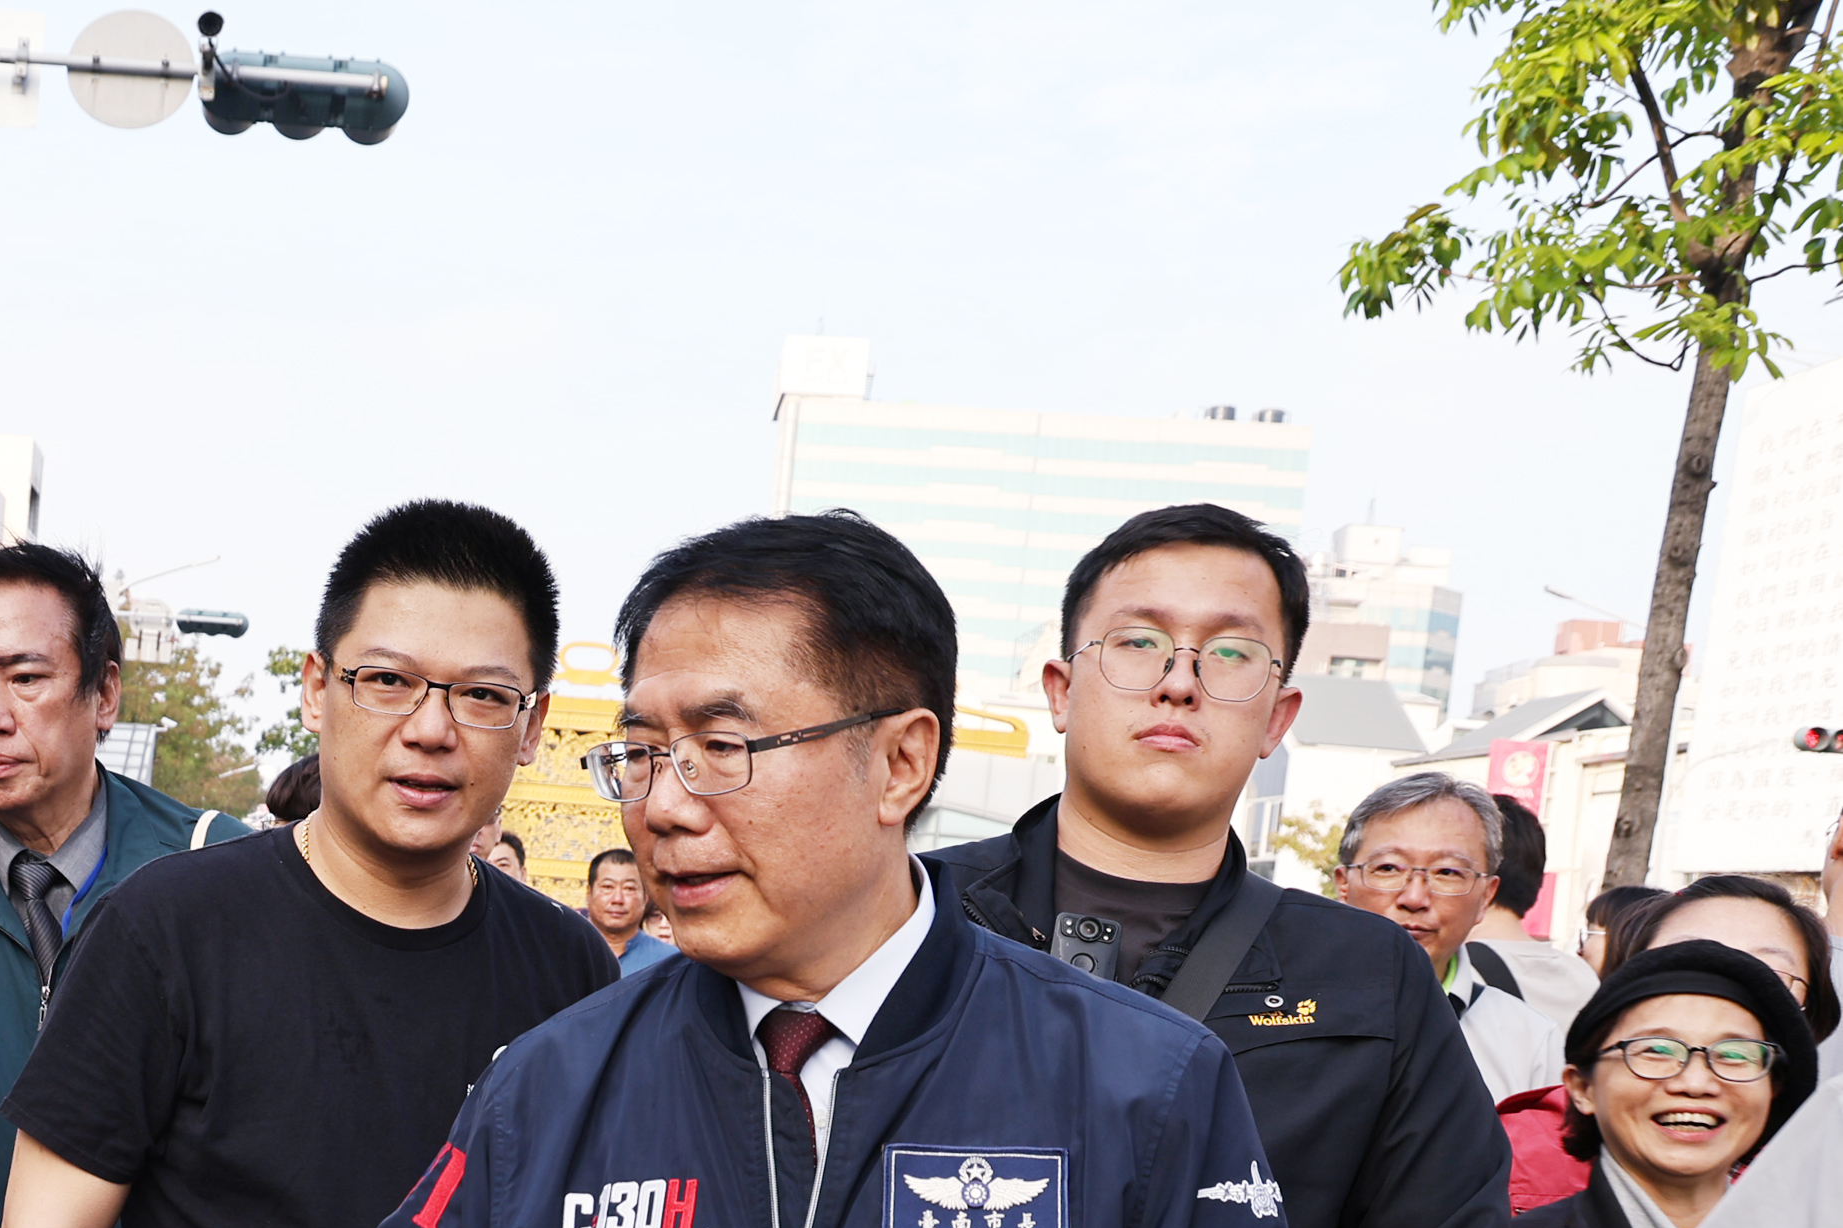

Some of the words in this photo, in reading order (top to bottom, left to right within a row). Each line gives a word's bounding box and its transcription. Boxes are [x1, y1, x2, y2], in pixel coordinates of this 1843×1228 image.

[1738, 540, 1843, 578] 如同行在
[1248, 1013, 1316, 1027] Wolfskin
